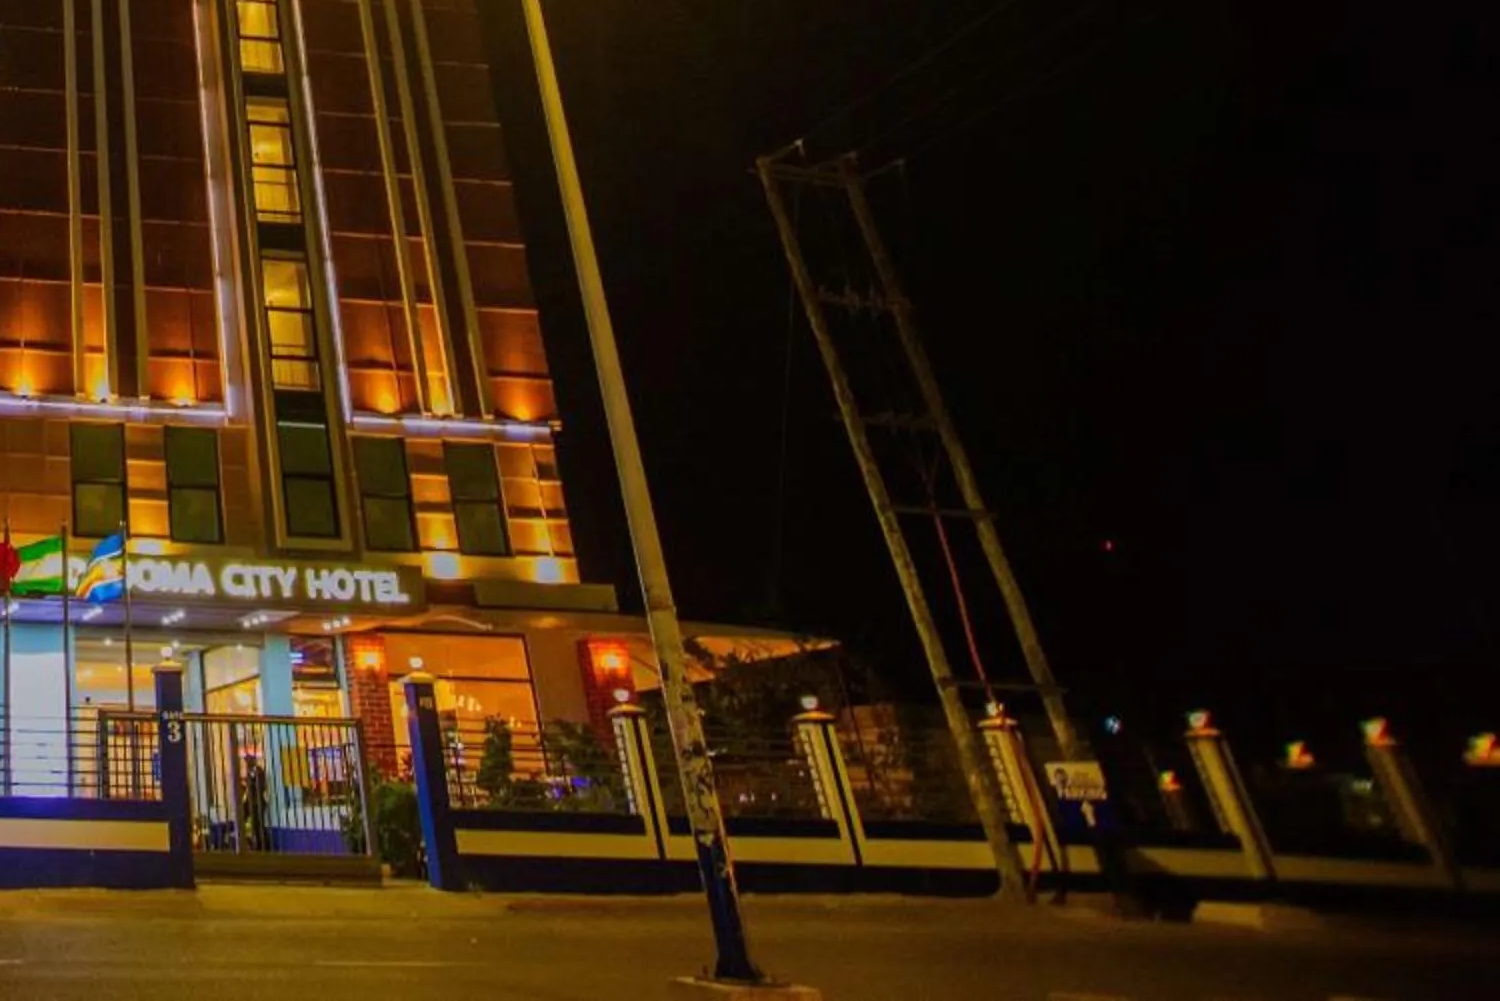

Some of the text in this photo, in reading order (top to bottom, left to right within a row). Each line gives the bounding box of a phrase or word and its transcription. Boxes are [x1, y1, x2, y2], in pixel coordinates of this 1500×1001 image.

[220, 564, 298, 599] CITY
[306, 567, 410, 604] HOTEL
[167, 721, 182, 743] 3
